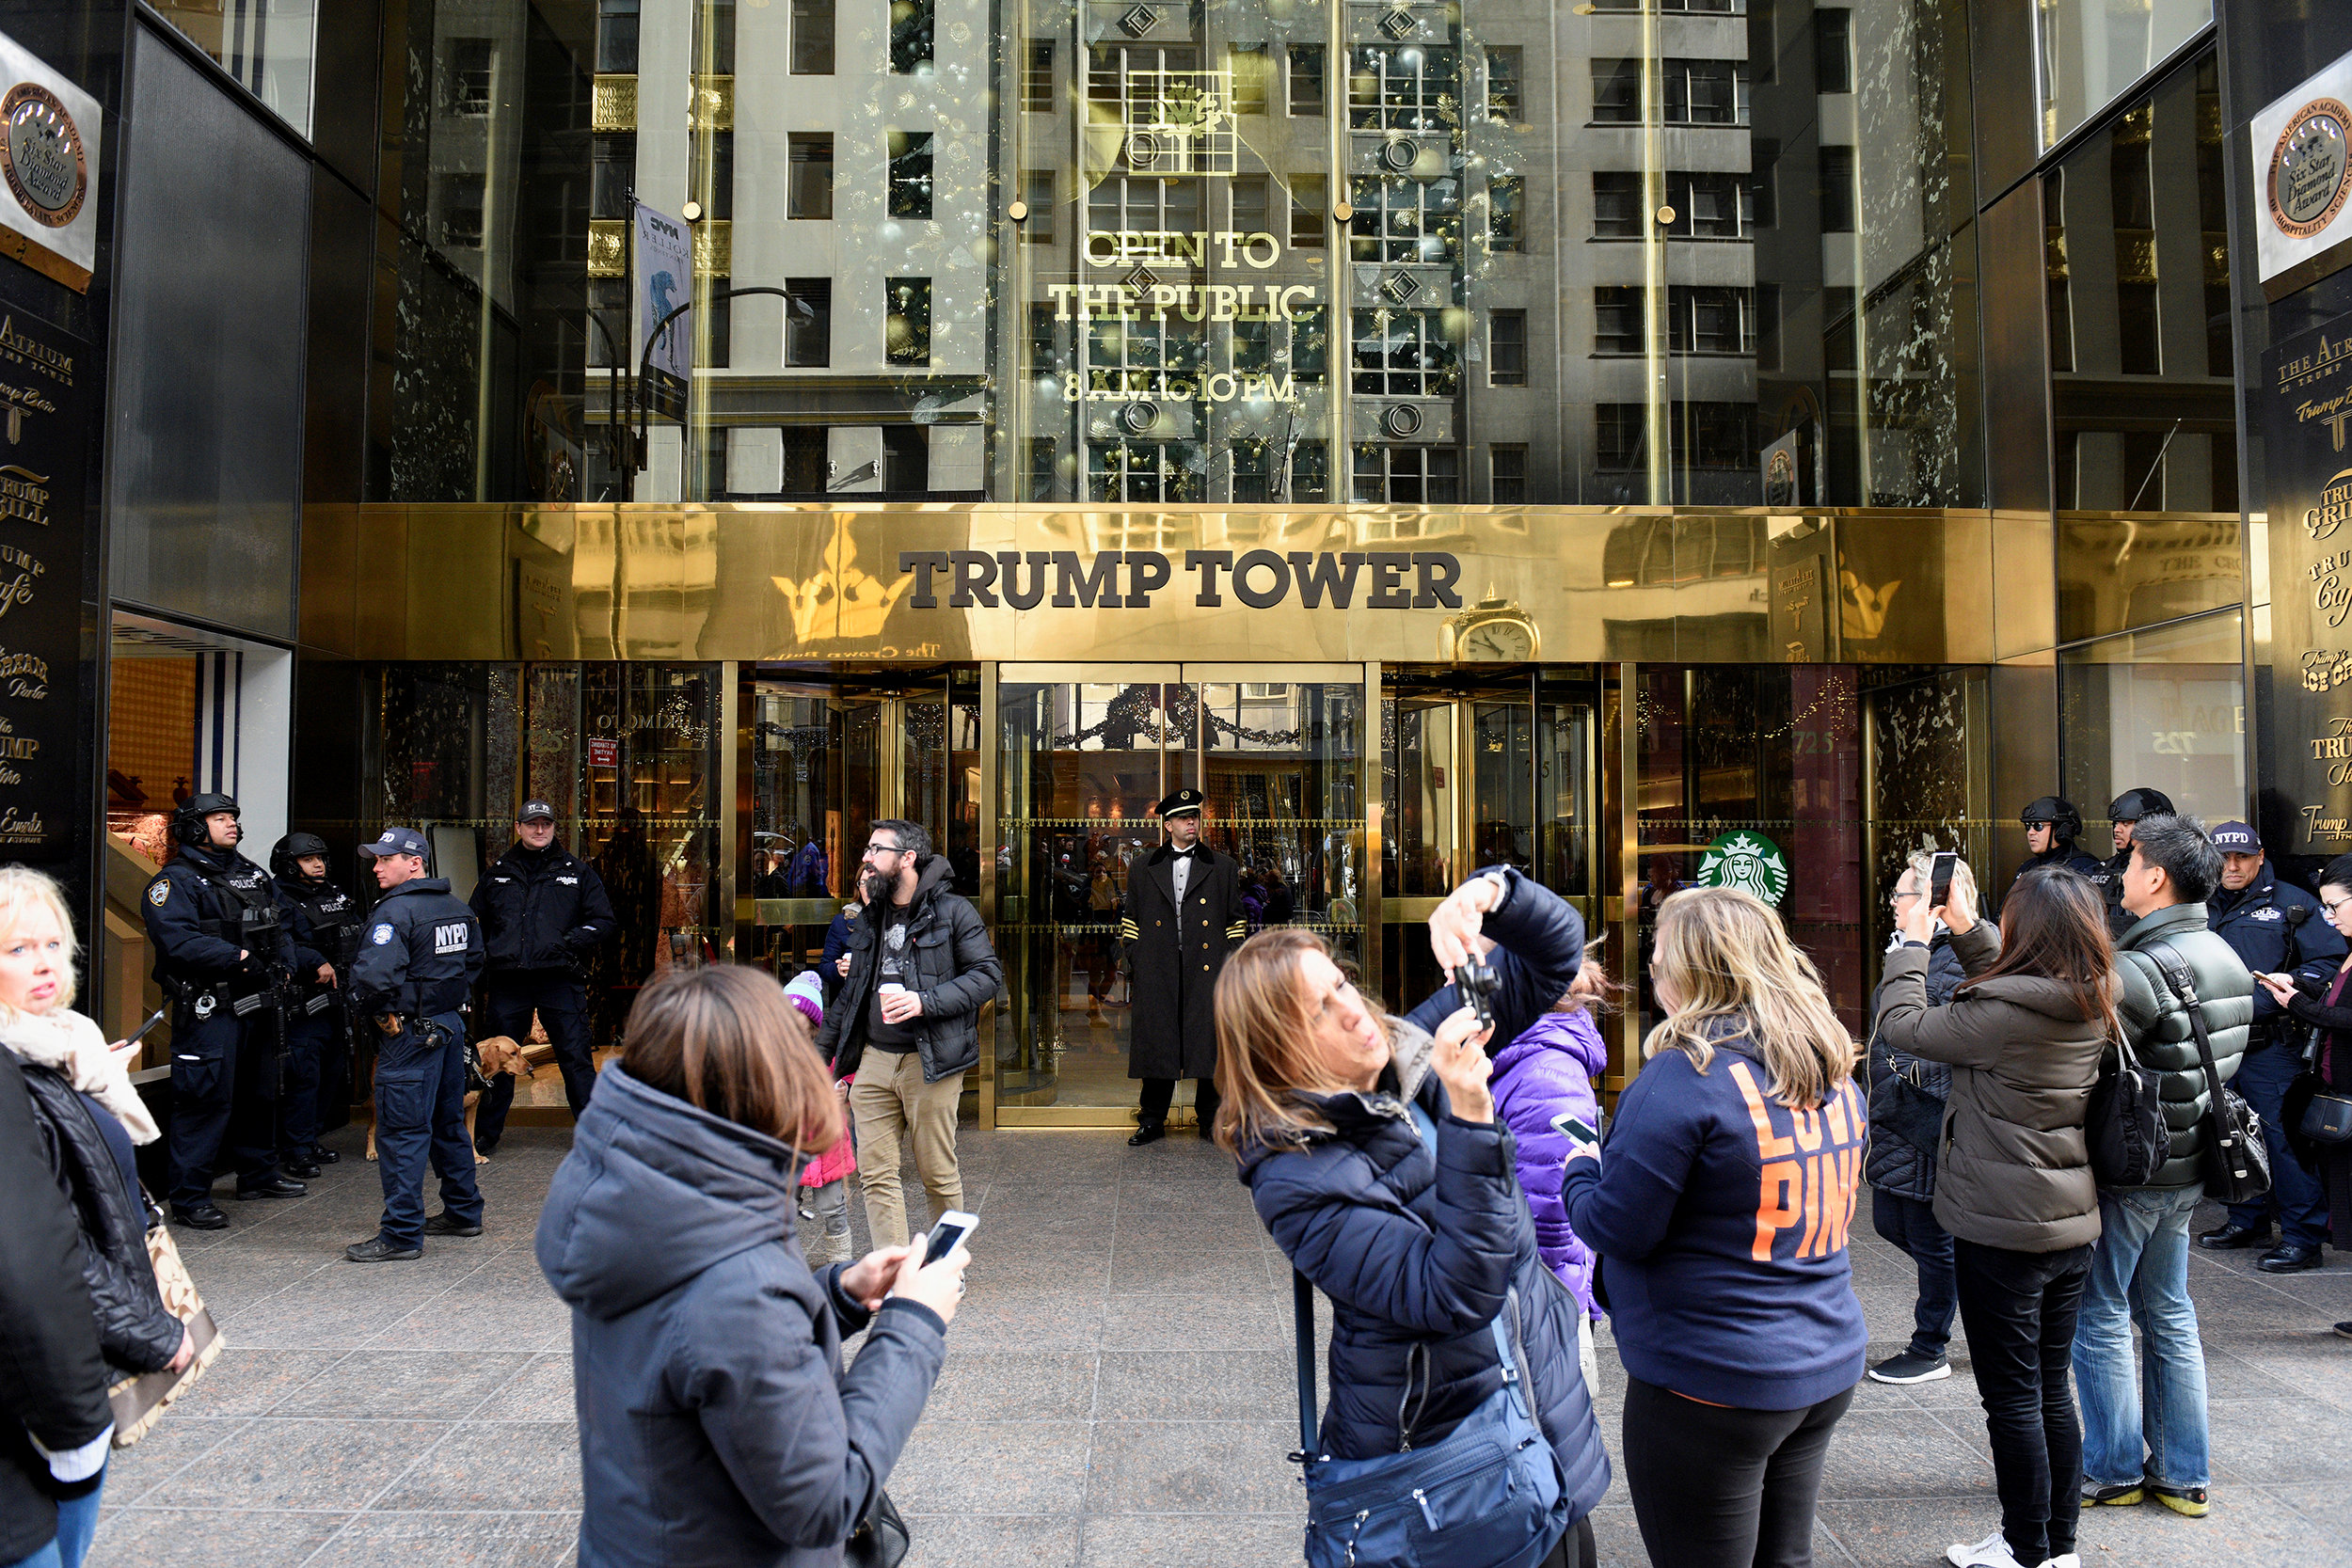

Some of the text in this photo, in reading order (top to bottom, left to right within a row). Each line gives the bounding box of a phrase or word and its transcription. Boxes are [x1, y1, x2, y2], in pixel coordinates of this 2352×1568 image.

[2279, 103, 2318, 149] AMERICAN
[2319, 101, 2352, 132] ACADEMY
[19, 150, 69, 189] Diamond
[43, 150, 66, 173] Star
[2289, 153, 2332, 187] Six Star
[2287, 162, 2335, 204] Diamond
[2293, 181, 2331, 215] Award
[2276, 213, 2328, 236] HOSPITALITY
[1084, 230, 1280, 269] OPEN TO
[1048, 284, 1316, 323] THE PUBLIC
[0, 315, 73, 372] ATRIUM
[2278, 334, 2352, 381] THE ATR
[31, 361, 74, 388] TOWER
[1063, 372, 1084, 403] 8
[1085, 373, 1152, 403] AM
[1241, 373, 1297, 403] PM
[2297, 362, 2343, 388] TRUMP
[2296, 396, 2345, 423] Trump
[2321, 483, 2352, 508] TRU
[2303, 500, 2352, 541] GRI
[0, 544, 46, 578] UMP
[2308, 550, 2351, 582] TRU
[898, 548, 1464, 610] TRUMP TOWER
[0, 573, 34, 619] afé
[0, 652, 49, 685] REAM
[2301, 648, 2349, 670] Trump's
[2302, 668, 2330, 693] ICE
[2328, 717, 2352, 737] Th
[1790, 731, 1835, 754] 725
[2311, 737, 2352, 760] TRU
[2328, 763, 2352, 787] St
[1, 806, 43, 834] Events
[2300, 804, 2348, 844] Trump
[2215, 832, 2249, 844] NYPD
[2340, 832, 2352, 841] TH
[229, 878, 258, 889] POLICE
[320, 902, 344, 913] POLICE
[435, 922, 469, 947] NYPD
[1752, 1146, 1862, 1262] PINK
